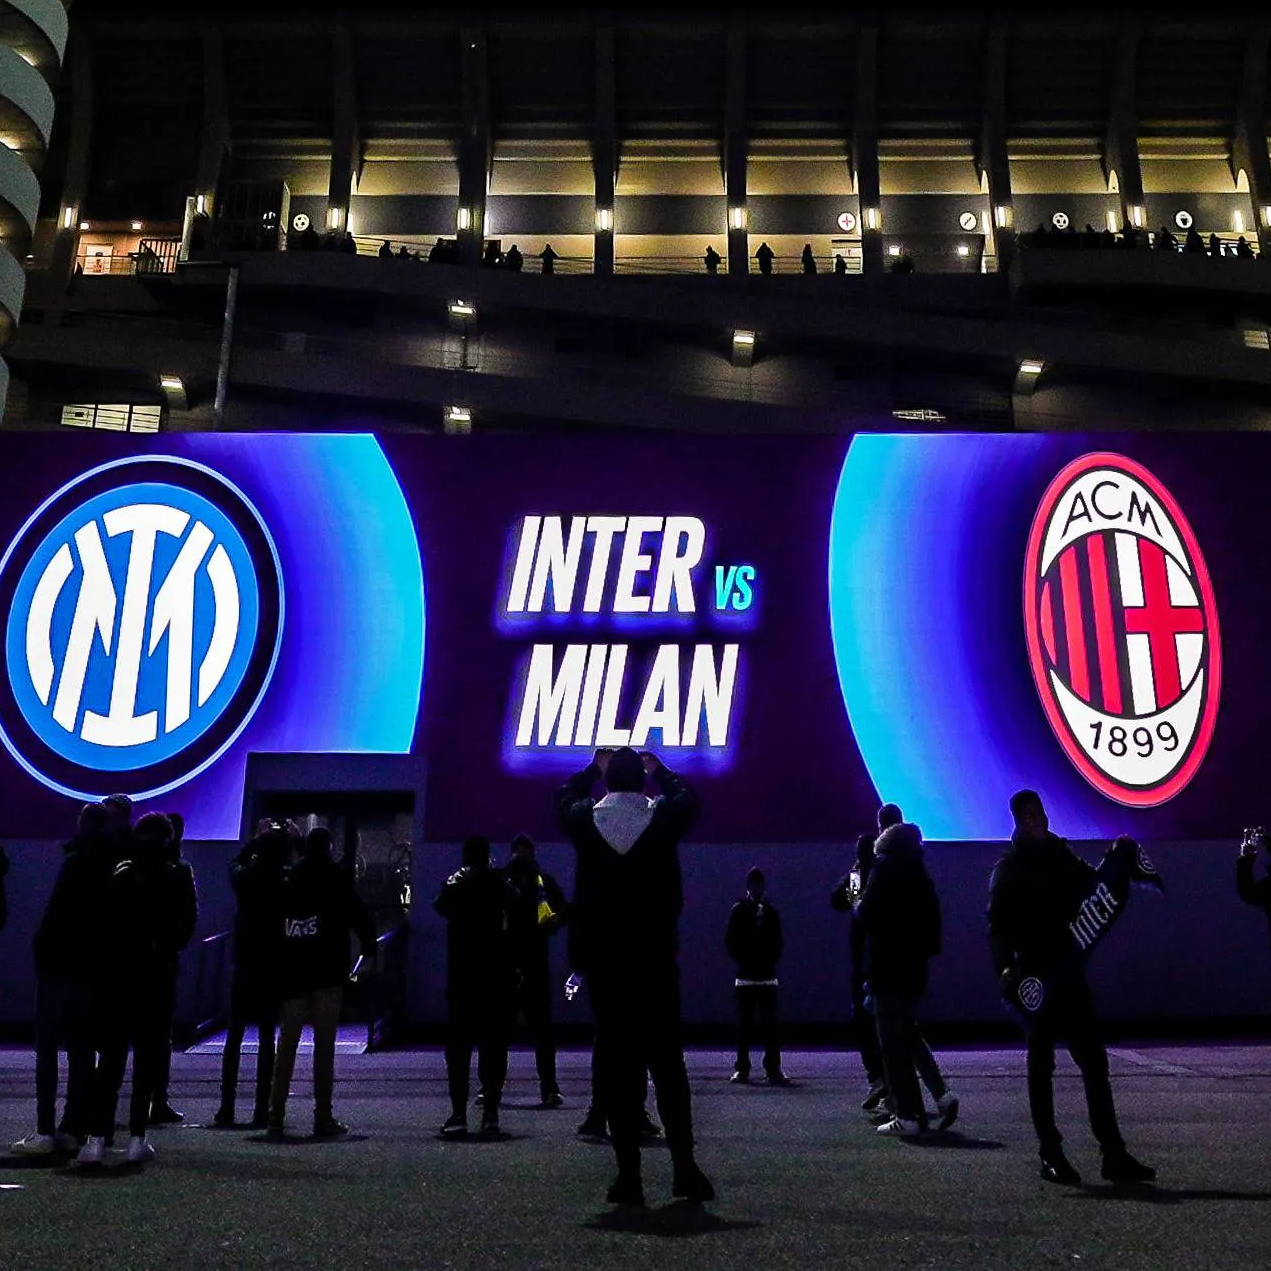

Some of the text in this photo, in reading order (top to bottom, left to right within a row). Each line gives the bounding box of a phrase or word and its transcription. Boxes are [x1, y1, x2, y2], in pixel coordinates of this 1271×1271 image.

[1062, 480, 1162, 537] ACM
[508, 516, 706, 613] INTER
[518, 644, 740, 747] MILAN
[1089, 721, 1180, 758] 1899
